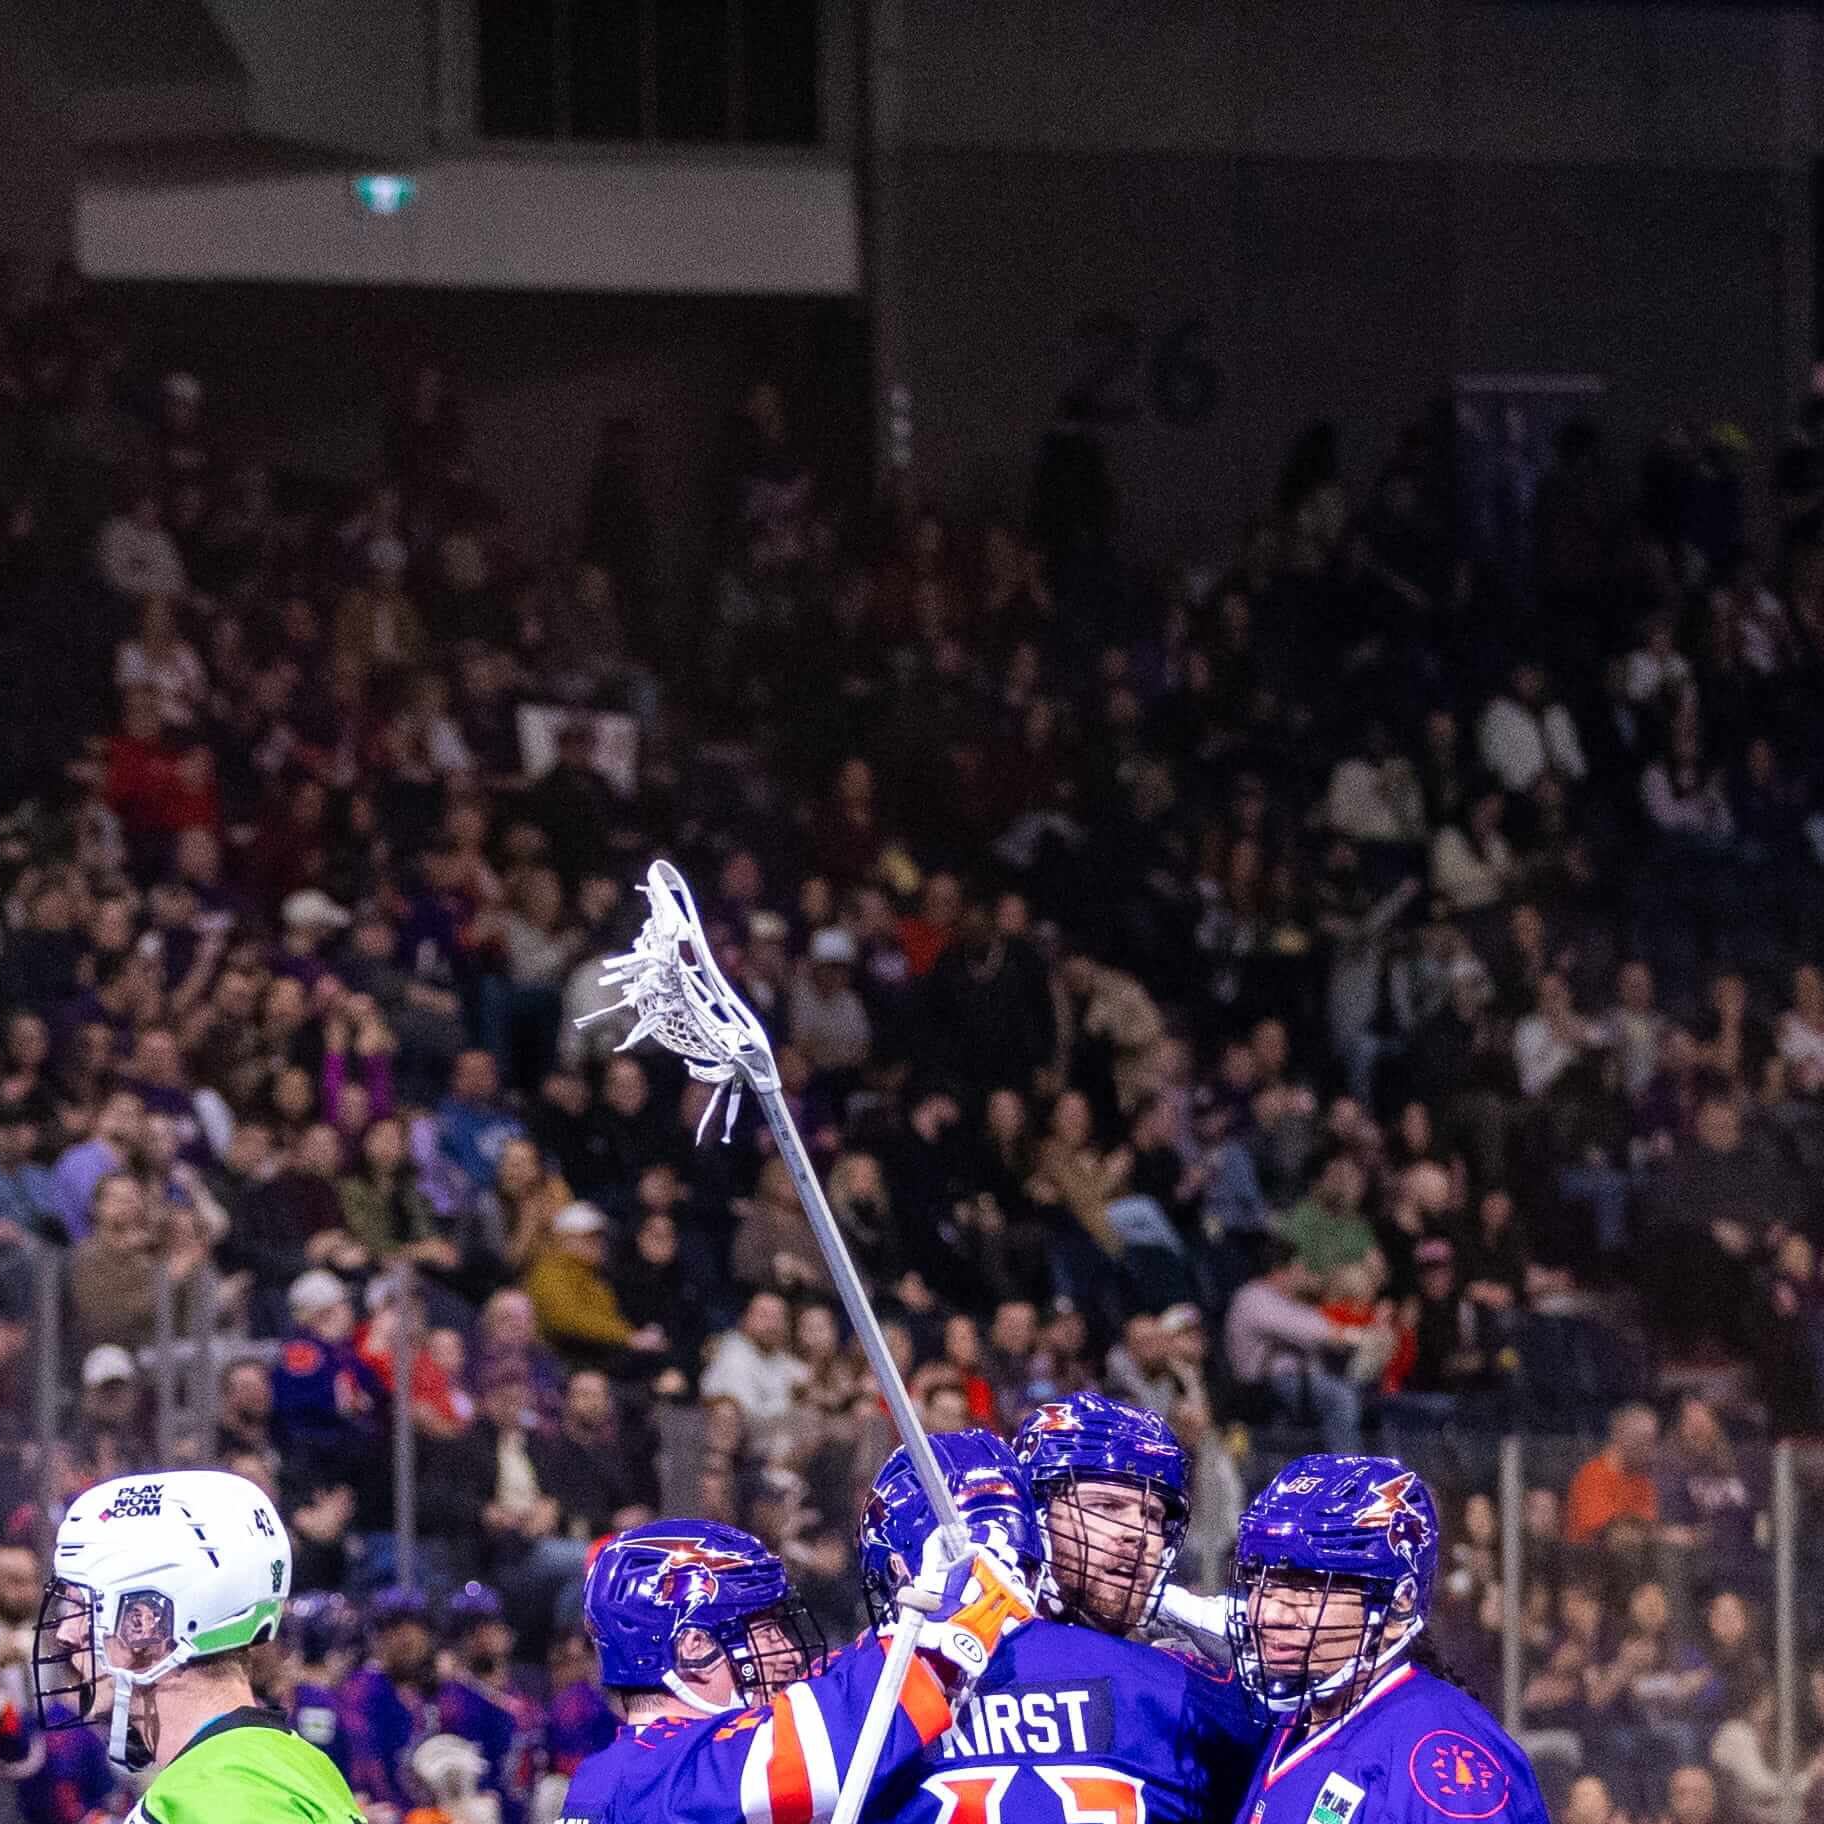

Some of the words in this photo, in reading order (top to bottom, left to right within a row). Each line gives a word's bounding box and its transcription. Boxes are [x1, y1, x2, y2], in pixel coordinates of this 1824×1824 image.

[114, 1494, 163, 1508] NOW
[117, 1484, 165, 1497] PLAY
[253, 1507, 275, 1537] 43
[941, 1690, 1091, 1758] KIRST
